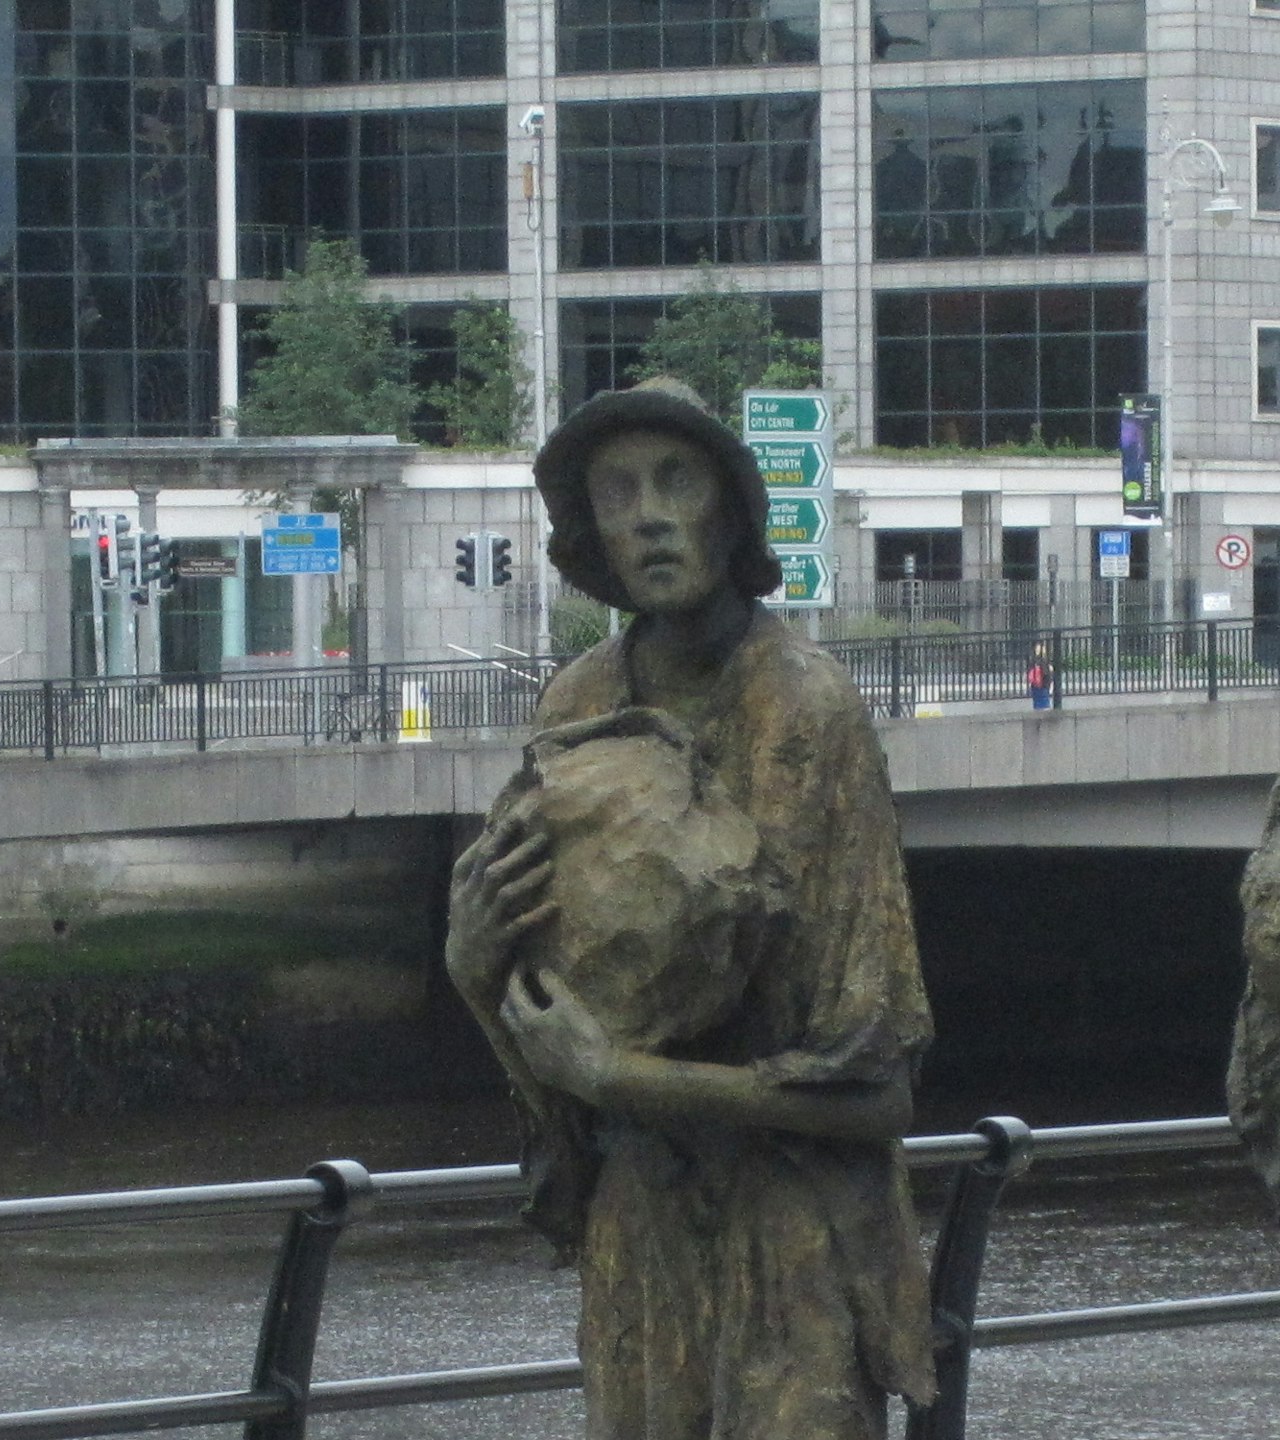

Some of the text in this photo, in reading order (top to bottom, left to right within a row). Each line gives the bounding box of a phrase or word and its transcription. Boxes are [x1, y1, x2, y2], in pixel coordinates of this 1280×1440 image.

[750, 417, 795, 428] CITY CENTRE
[756, 458, 801, 470] HE NORTH
[771, 514, 799, 526] WEST
